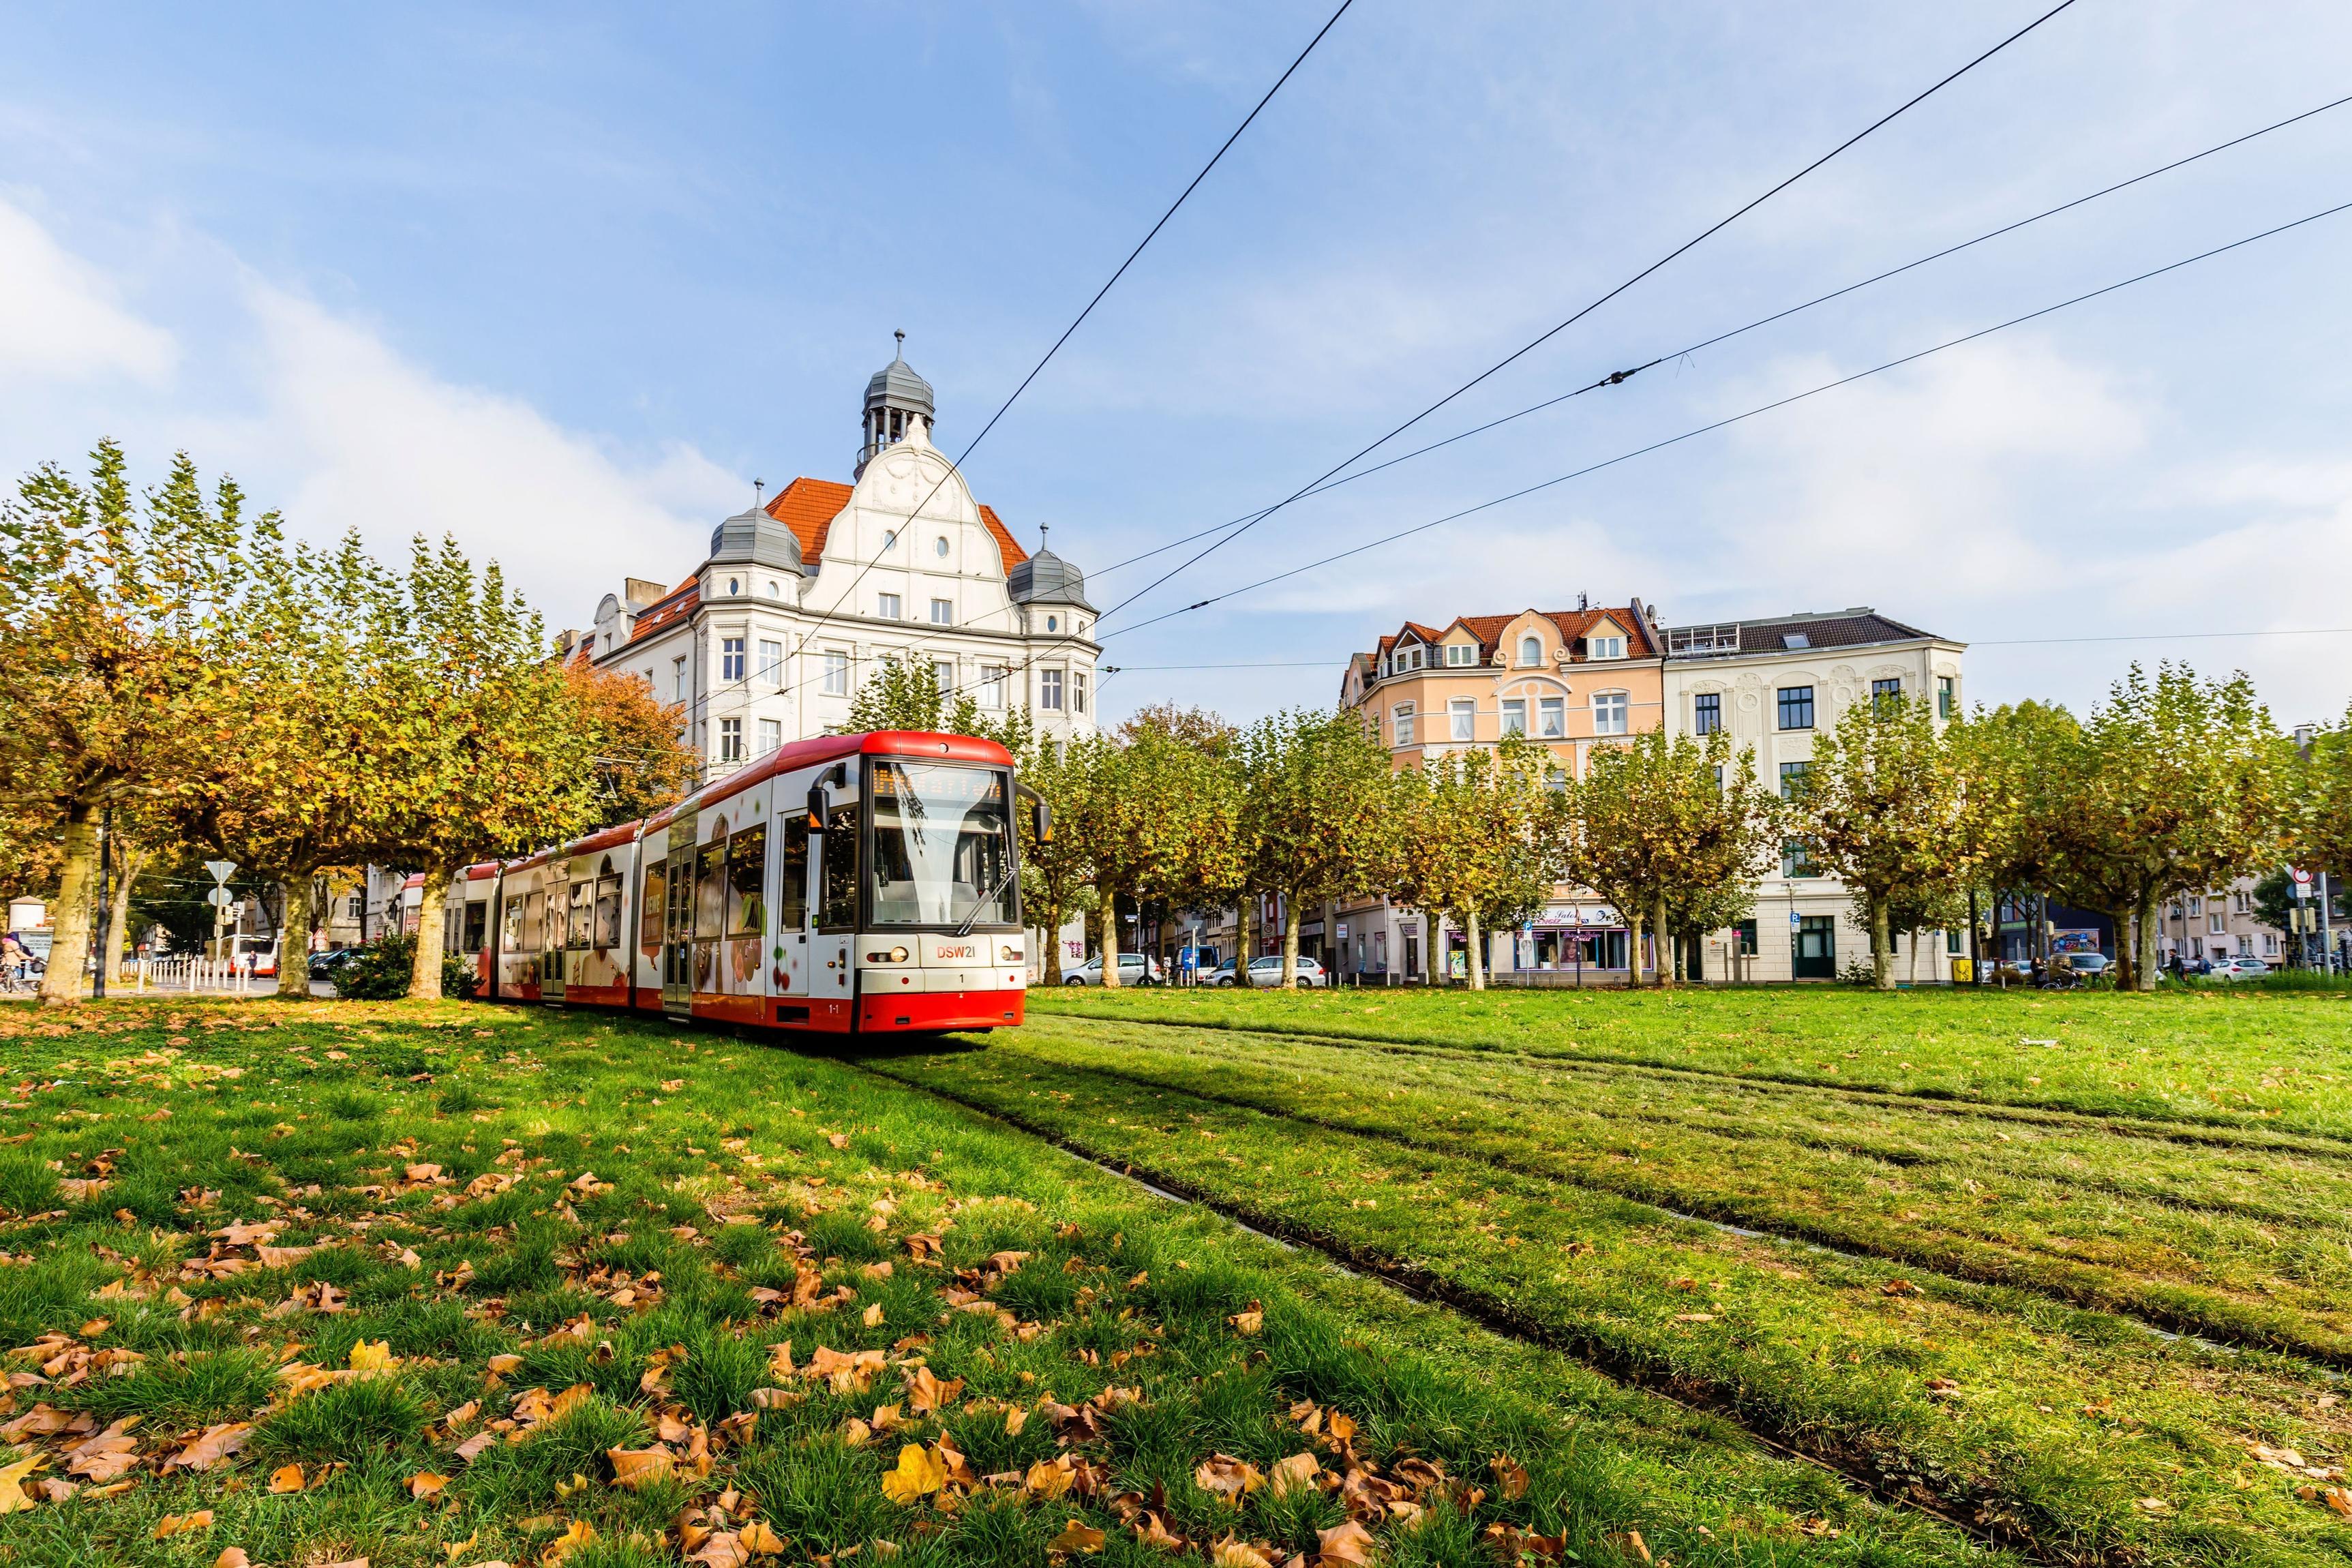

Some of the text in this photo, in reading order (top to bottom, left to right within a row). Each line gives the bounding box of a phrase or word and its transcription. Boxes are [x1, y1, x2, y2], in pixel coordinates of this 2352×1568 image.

[645, 894, 661, 916] REWE
[1555, 910, 1578, 919] Salo
[937, 946, 976, 958] DSW21
[959, 974, 964, 983] 1
[829, 1004, 839, 1014] 1-1
